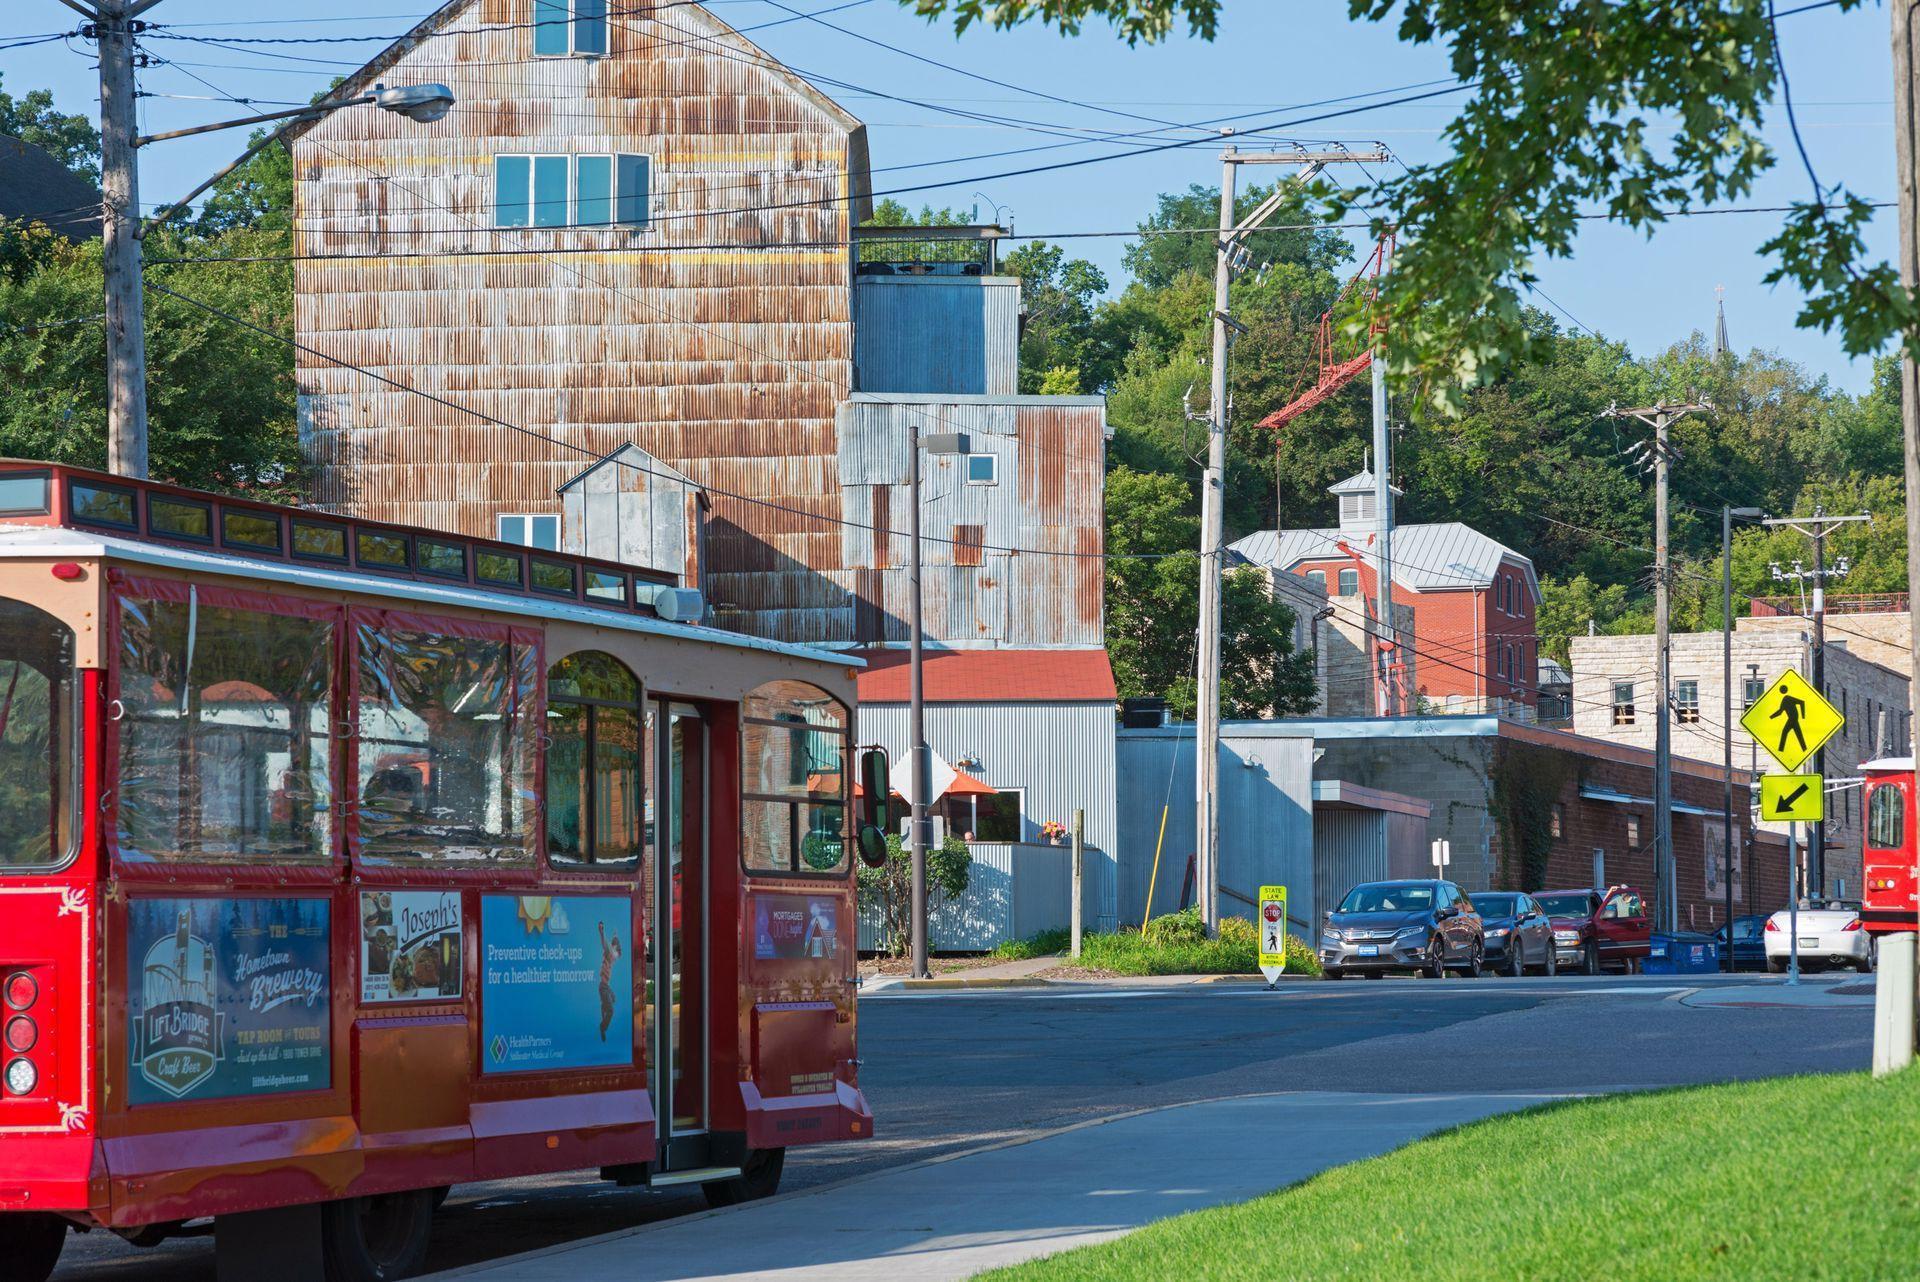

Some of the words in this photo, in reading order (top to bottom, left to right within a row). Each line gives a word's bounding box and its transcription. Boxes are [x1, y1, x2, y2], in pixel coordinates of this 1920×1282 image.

[401, 892, 458, 948] Joseph's
[773, 911, 804, 921] MORTGAGES
[1265, 909, 1281, 917] STOP
[268, 925, 288, 938] THE
[487, 944, 537, 961] Preventive
[538, 943, 583, 964] check-ups
[236, 948, 289, 981] Hometown
[487, 967, 502, 984] for
[503, 971, 510, 984] a
[511, 966, 552, 983] healthier
[552, 969, 597, 983] tomorrow.
[249, 966, 323, 1011] Brewery
[149, 1014, 171, 1046] LIFT
[170, 1006, 209, 1036] BRIDGE
[237, 1030, 256, 1045] TAP
[257, 1028, 283, 1043] ROOM
[293, 1026, 321, 1041] TOURS
[159, 1057, 180, 1078] Craft
[181, 1056, 201, 1074] Beer
